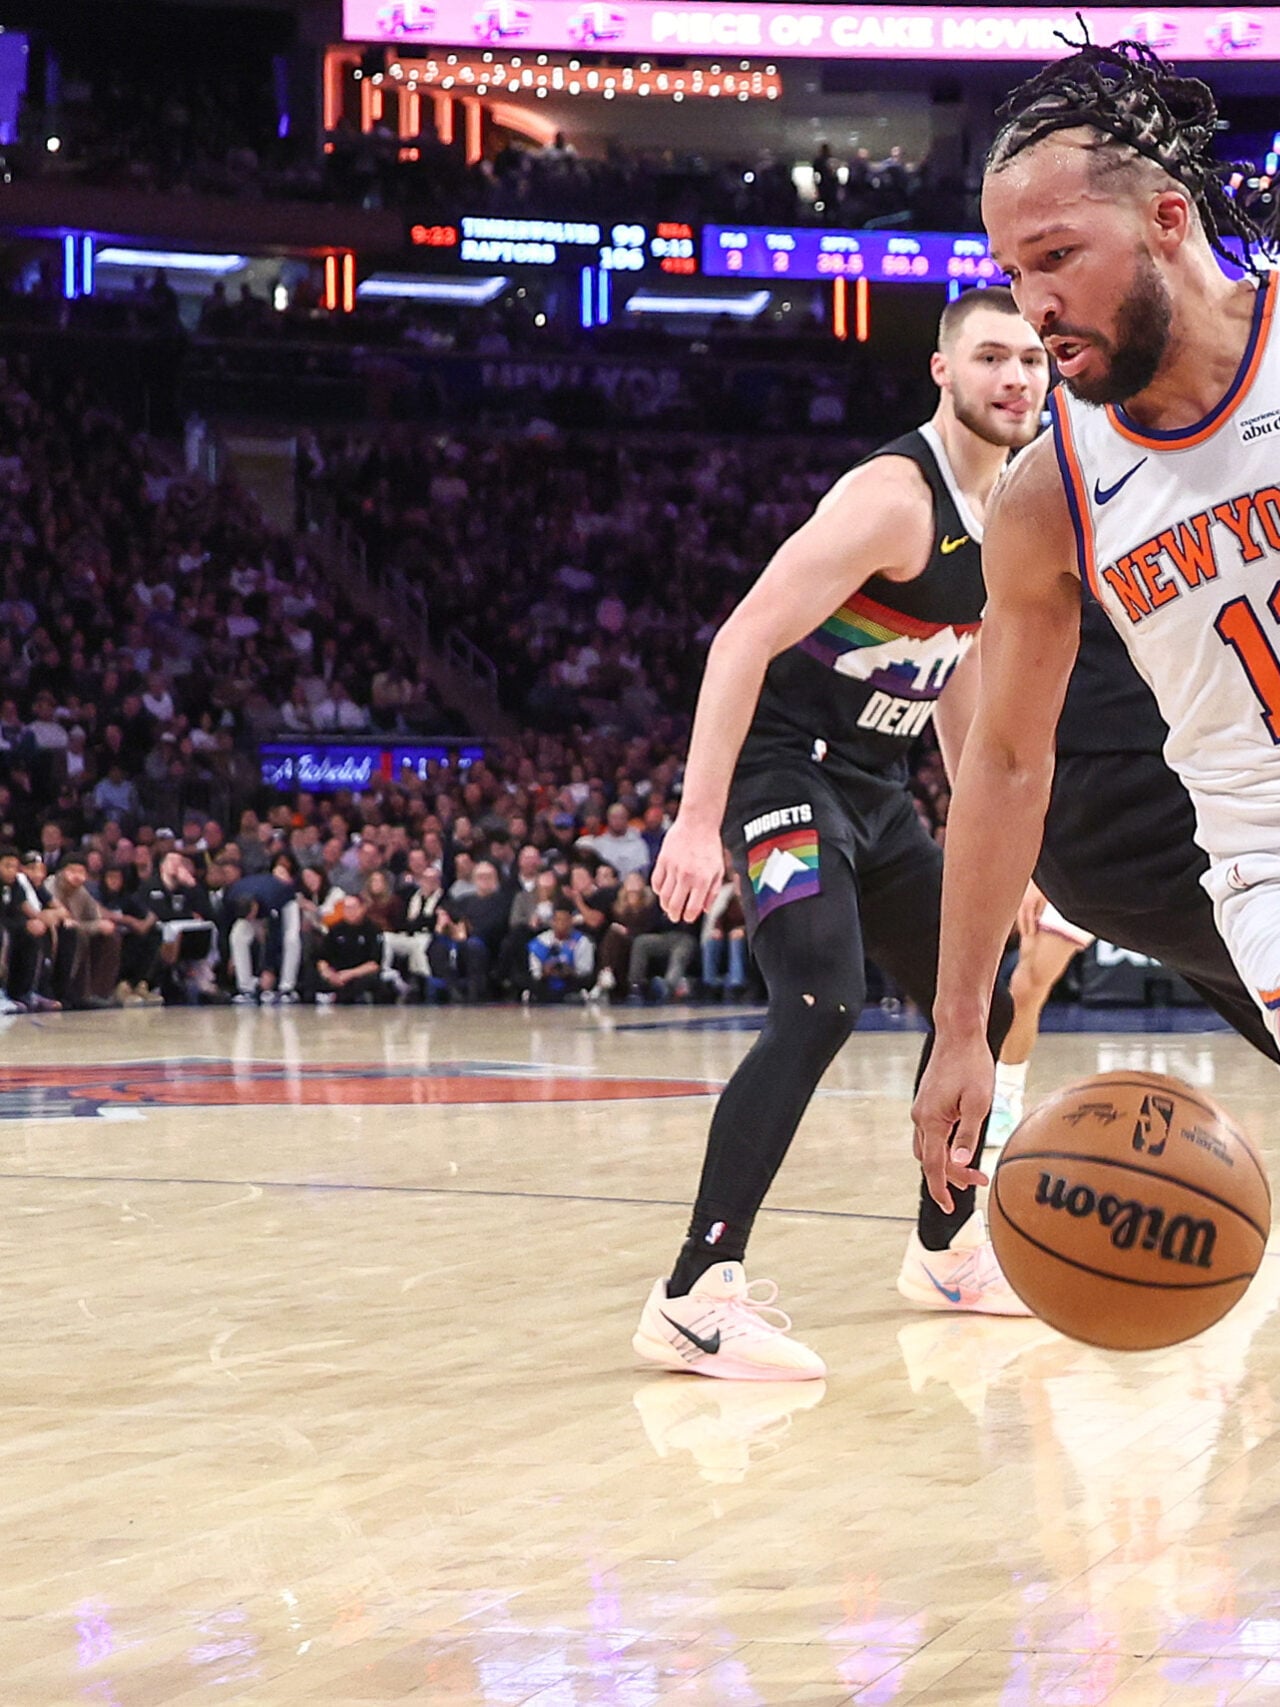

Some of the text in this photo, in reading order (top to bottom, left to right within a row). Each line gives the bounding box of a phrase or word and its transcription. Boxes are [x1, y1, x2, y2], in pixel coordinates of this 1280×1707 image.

[651, 11, 762, 44] PIECE
[769, 14, 823, 45] OF
[831, 16, 933, 48] CAKE
[1242, 423, 1272, 441] abu
[1101, 512, 1220, 624] NEW
[856, 690, 938, 738] DENV
[743, 803, 813, 844] NUGGETS
[1034, 1171, 1218, 1268] Wilson
